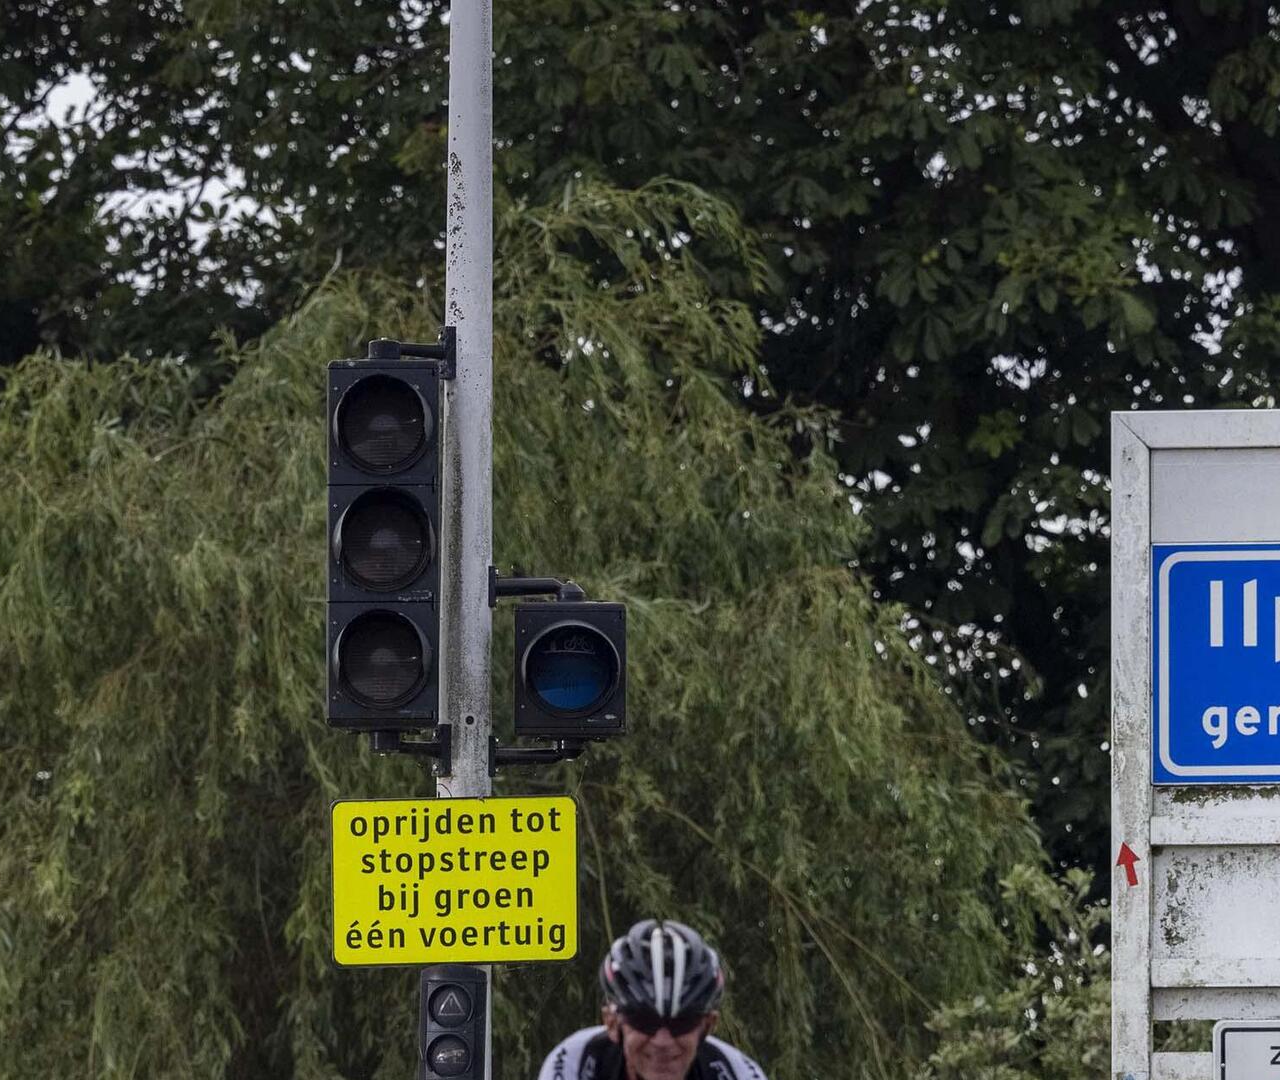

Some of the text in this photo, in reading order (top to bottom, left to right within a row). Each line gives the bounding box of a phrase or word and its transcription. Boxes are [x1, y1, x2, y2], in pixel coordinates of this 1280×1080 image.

[351, 808, 560, 843] oprijden tot
[362, 847, 549, 880] stopstreep
[379, 883, 532, 918] bij groen
[346, 918, 565, 952] één voertuig
